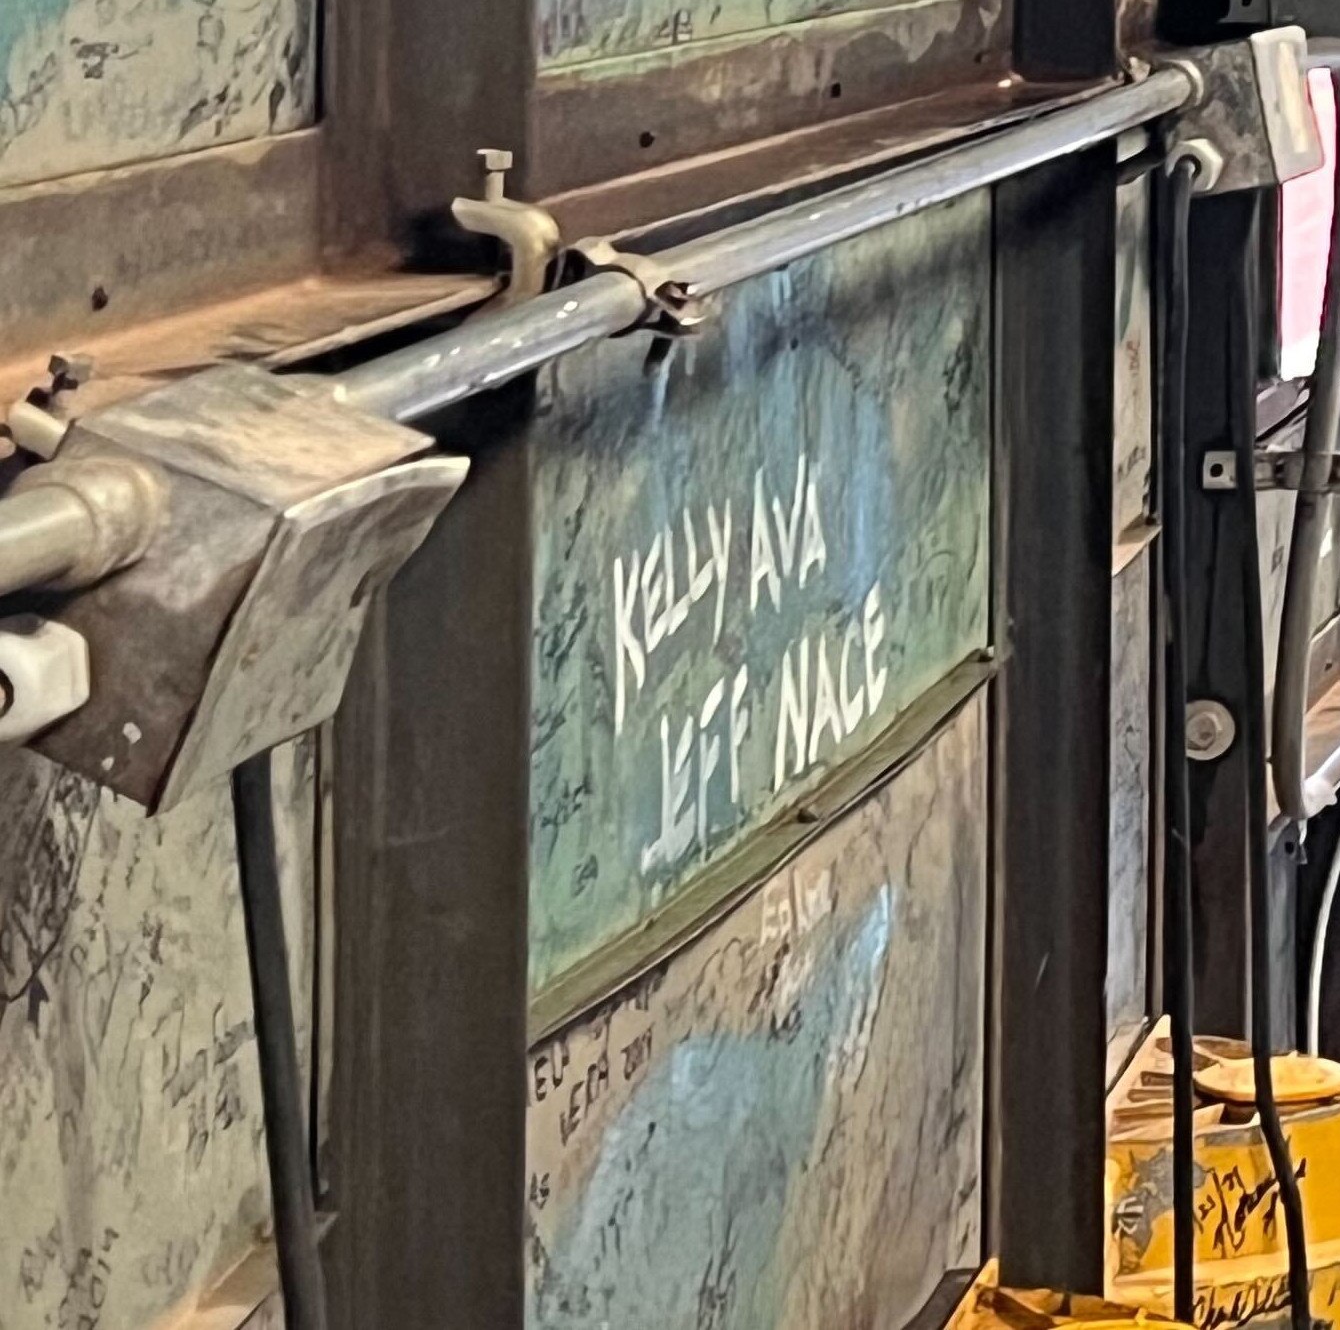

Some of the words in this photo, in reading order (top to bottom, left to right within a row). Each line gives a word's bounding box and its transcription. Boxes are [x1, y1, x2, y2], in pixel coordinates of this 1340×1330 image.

[613, 490, 733, 738] KELLY
[749, 453, 827, 618] AVA
[641, 663, 749, 877] JEFF
[773, 577, 889, 796] NACE
